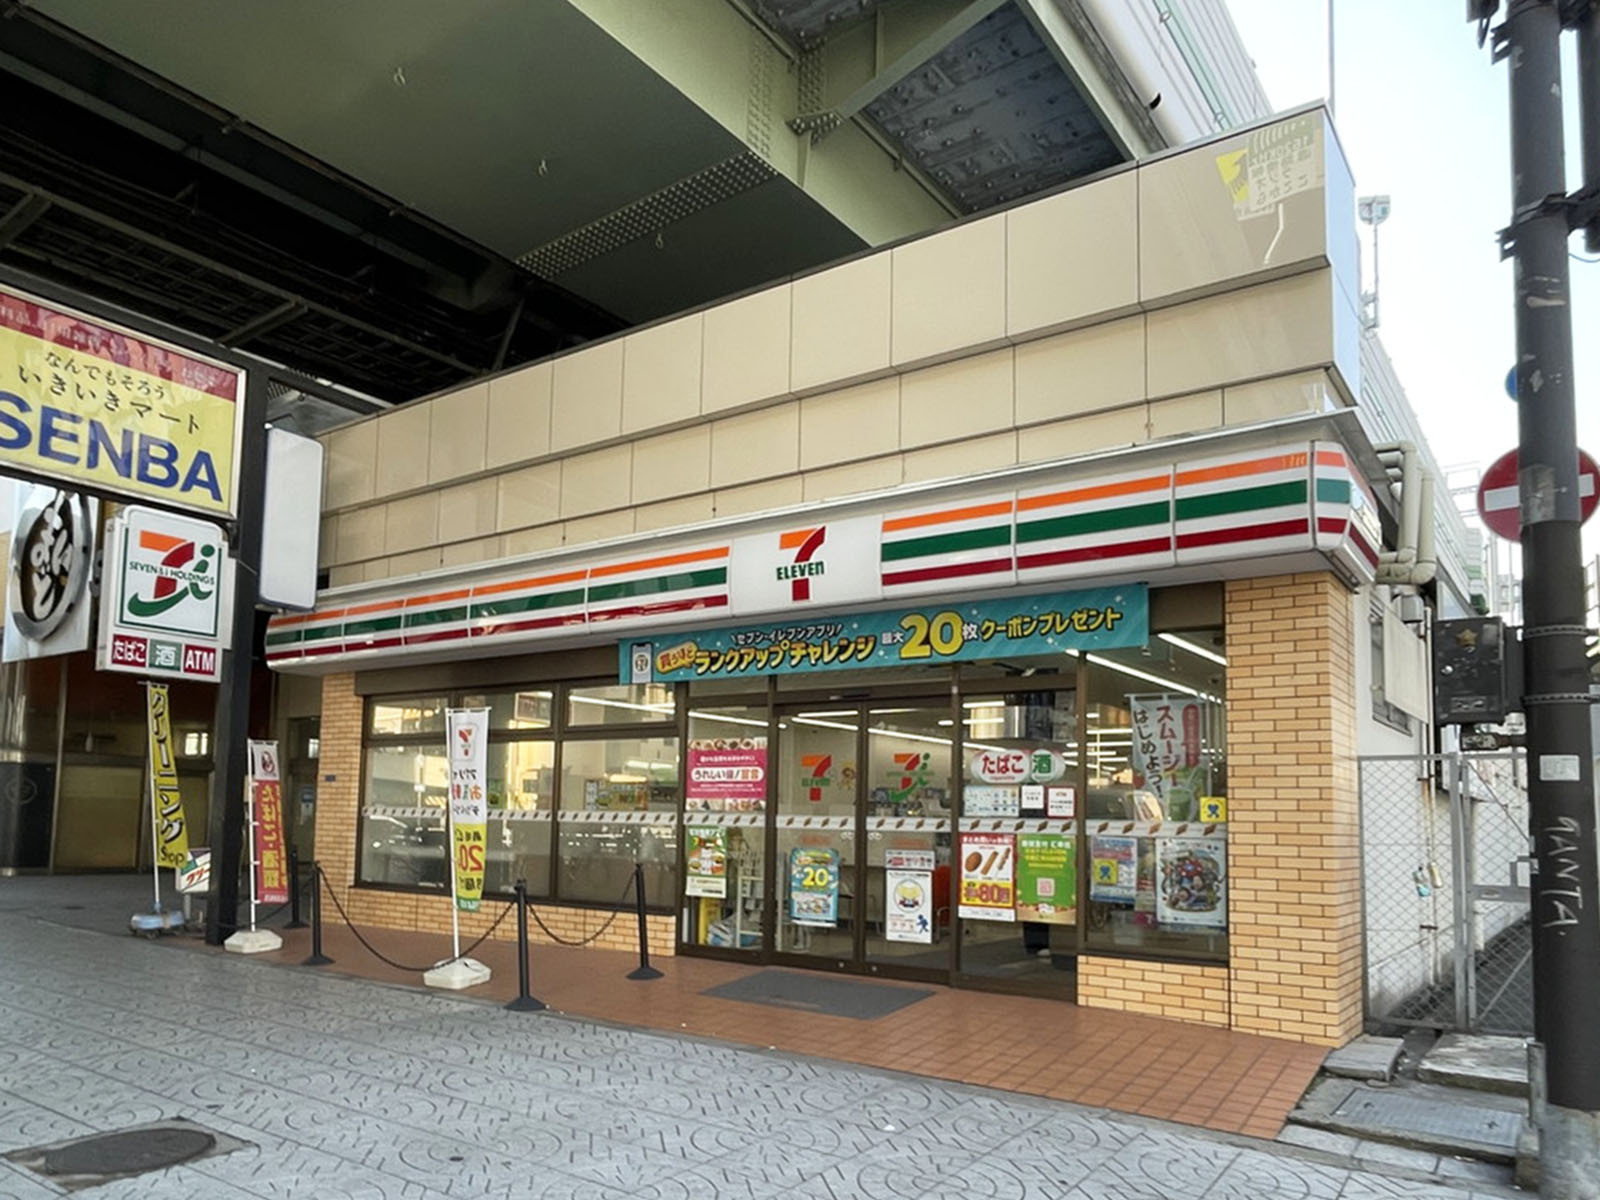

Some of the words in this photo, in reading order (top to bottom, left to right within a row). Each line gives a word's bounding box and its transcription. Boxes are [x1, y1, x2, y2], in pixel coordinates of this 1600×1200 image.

[18, 364, 200, 435] いきいきマート
[45, 350, 165, 400] なんでもそろう
[0, 390, 224, 503] SENBA
[113, 640, 147, 663] たばこ
[155, 644, 176, 667] 酒
[184, 650, 214, 672] ATM
[982, 754, 1024, 774] たばこ
[1032, 753, 1052, 774] 酒
[1156, 704, 1181, 787] スムージー
[802, 867, 831, 887] 20
